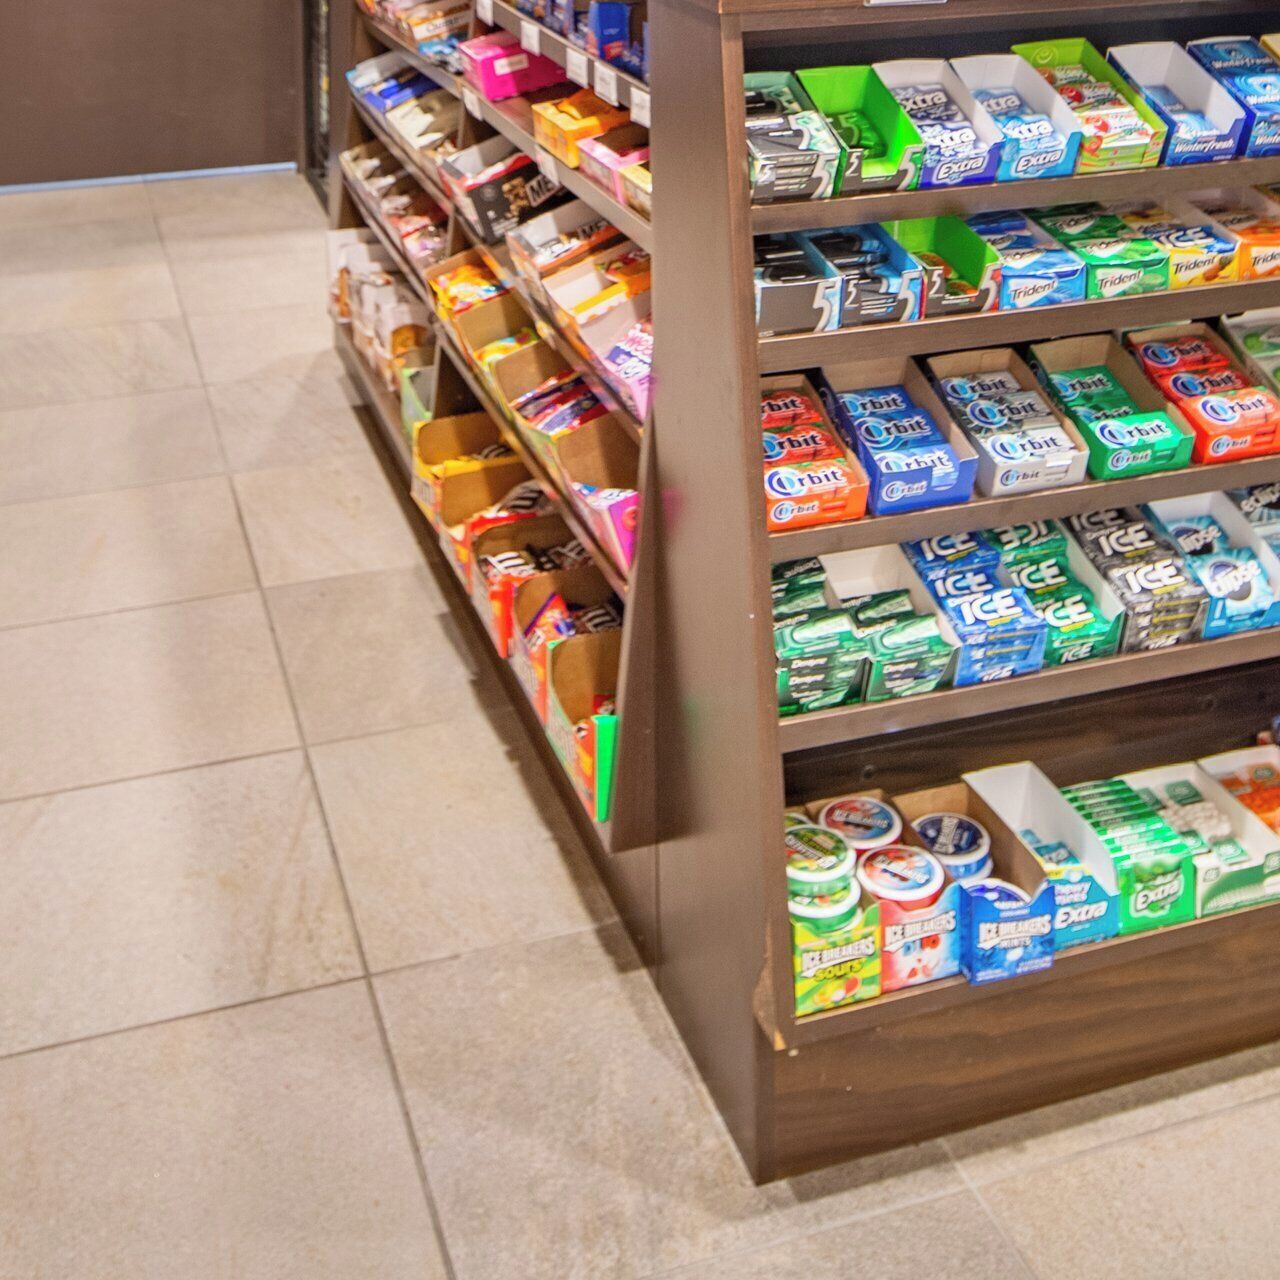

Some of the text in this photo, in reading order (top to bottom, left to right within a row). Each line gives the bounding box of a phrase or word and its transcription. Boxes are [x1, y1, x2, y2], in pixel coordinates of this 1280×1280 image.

[1173, 136, 1235, 155] Winterfresh
[937, 155, 986, 182] Extra
[1017, 149, 1064, 172] Extra
[1172, 255, 1218, 276] Trident
[1009, 279, 1058, 302] Trident
[1096, 269, 1143, 294] Trident
[970, 399, 1041, 428] Orbit
[988, 431, 1064, 461] Orbit
[766, 466, 847, 498] Orbit
[881, 478, 928, 502] Orbit
[1000, 467, 1041, 488] Orbit
[771, 499, 819, 522] Orbit
[919, 531, 978, 562] ICE
[1010, 557, 1069, 591] ICE
[961, 587, 1024, 627] ICE
[1042, 595, 1096, 630] ICE
[1061, 643, 1094, 664] ICE
[1133, 868, 1183, 913] Extra
[904, 909, 957, 937] BREAKERS
[999, 913, 1052, 938] BREAKERS
[1054, 901, 1109, 930] Extra
[823, 935, 877, 960] BREAKERS
[903, 933, 941, 957] DUO
